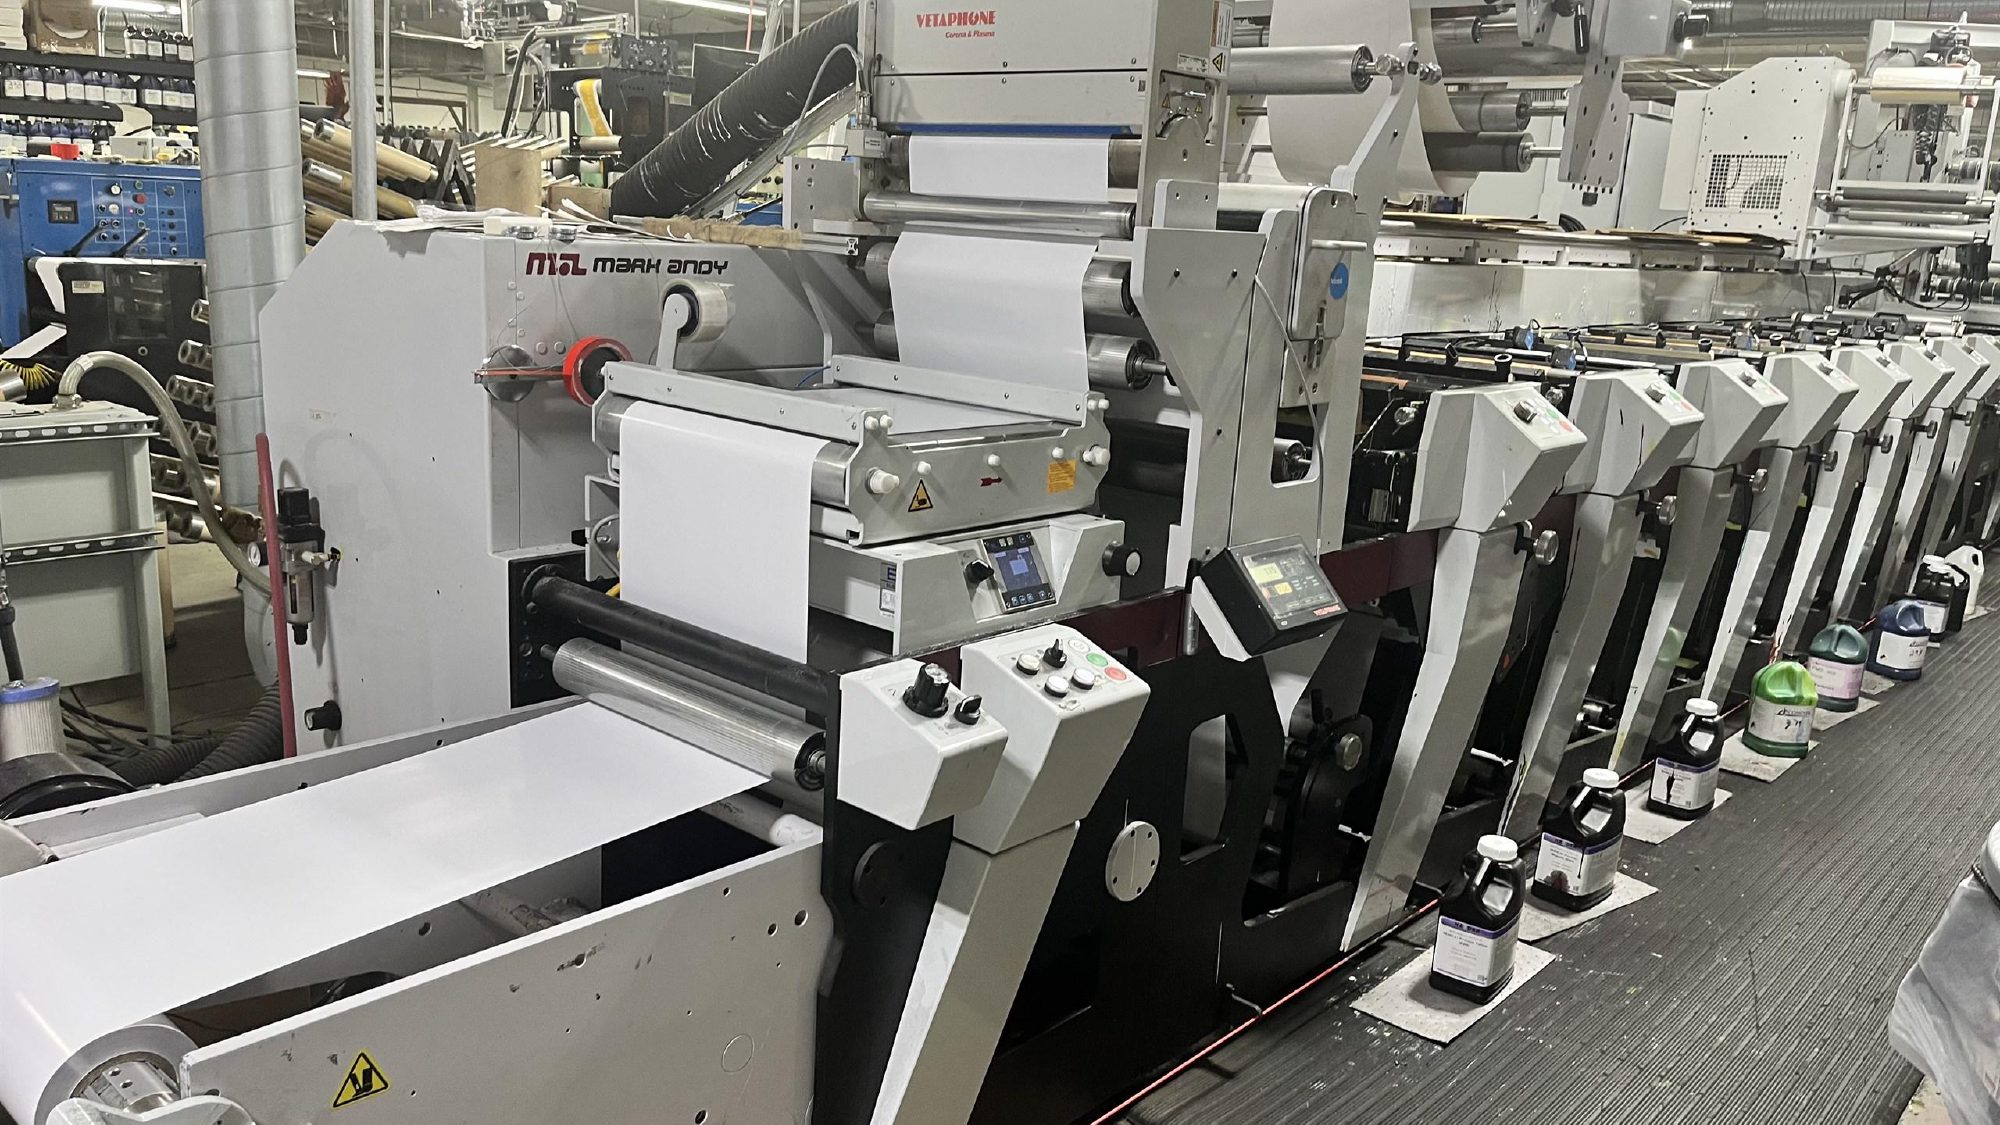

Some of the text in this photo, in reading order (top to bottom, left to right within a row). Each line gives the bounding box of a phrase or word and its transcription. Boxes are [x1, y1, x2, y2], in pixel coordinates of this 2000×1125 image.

[916, 10, 996, 29] VETAPHONE
[945, 29, 995, 39] Corona & Plasma
